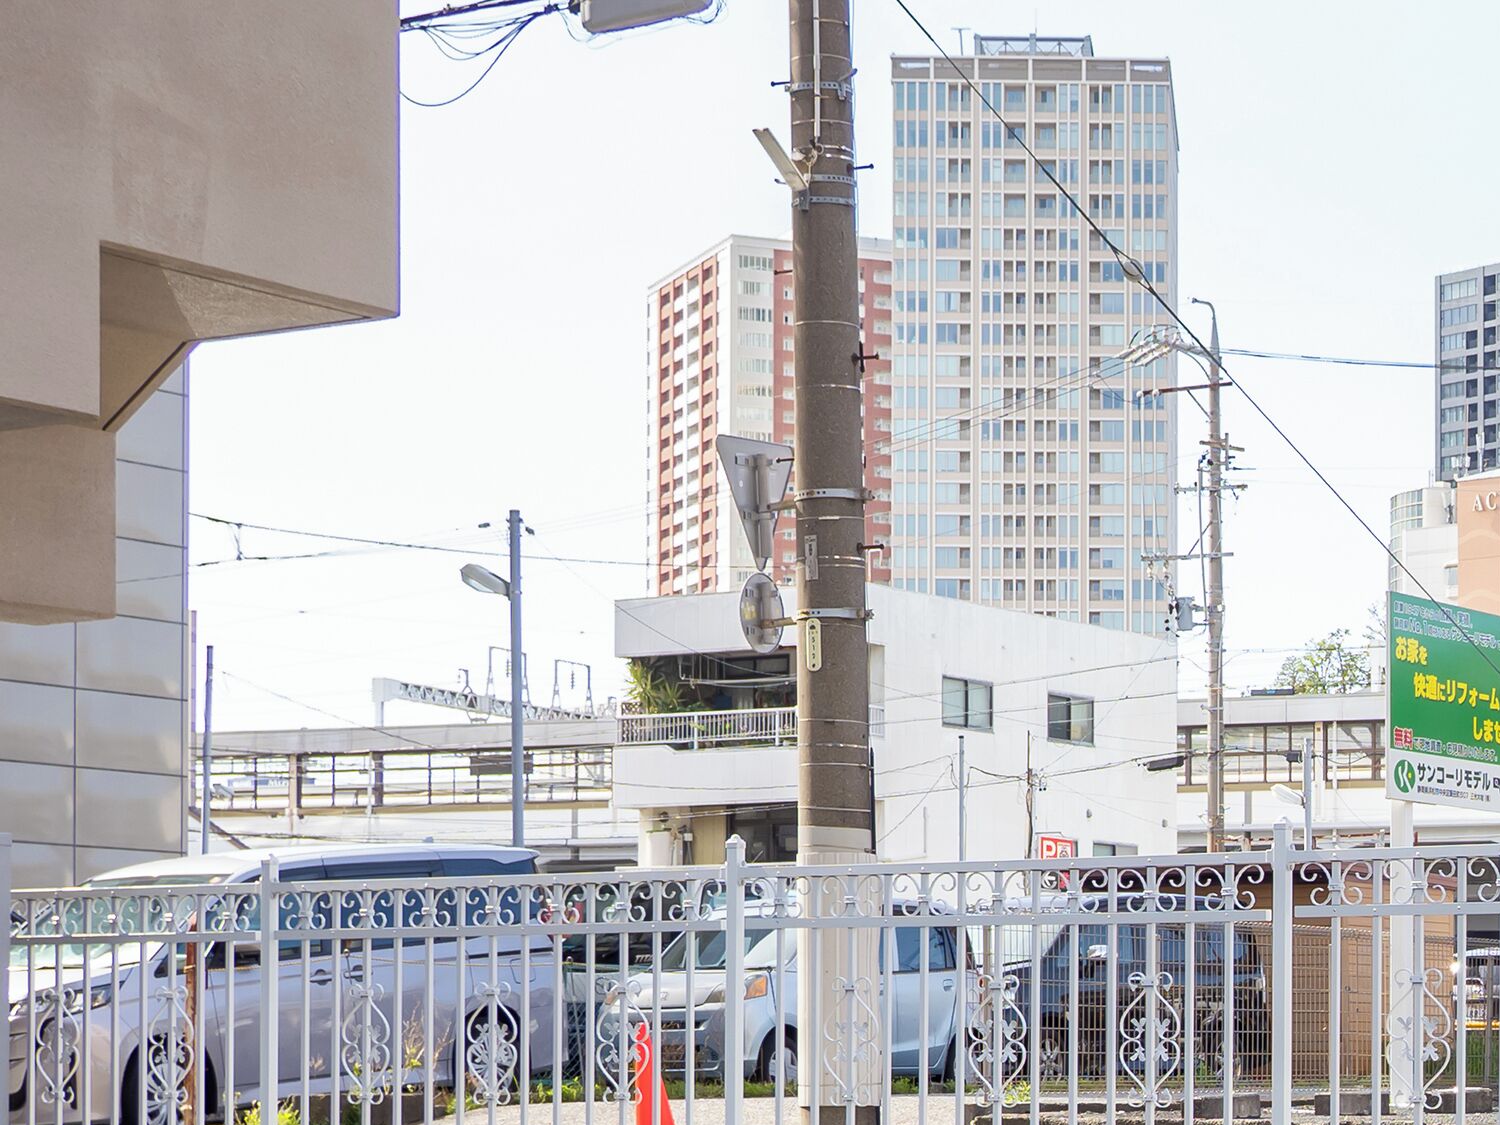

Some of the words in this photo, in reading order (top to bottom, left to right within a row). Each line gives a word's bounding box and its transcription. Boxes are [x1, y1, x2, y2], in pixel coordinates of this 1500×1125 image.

[1395, 636, 1428, 666] お家を
[1413, 672, 1500, 711] 快適にリフォーム
[1417, 762, 1491, 791] サンコーリモデル
